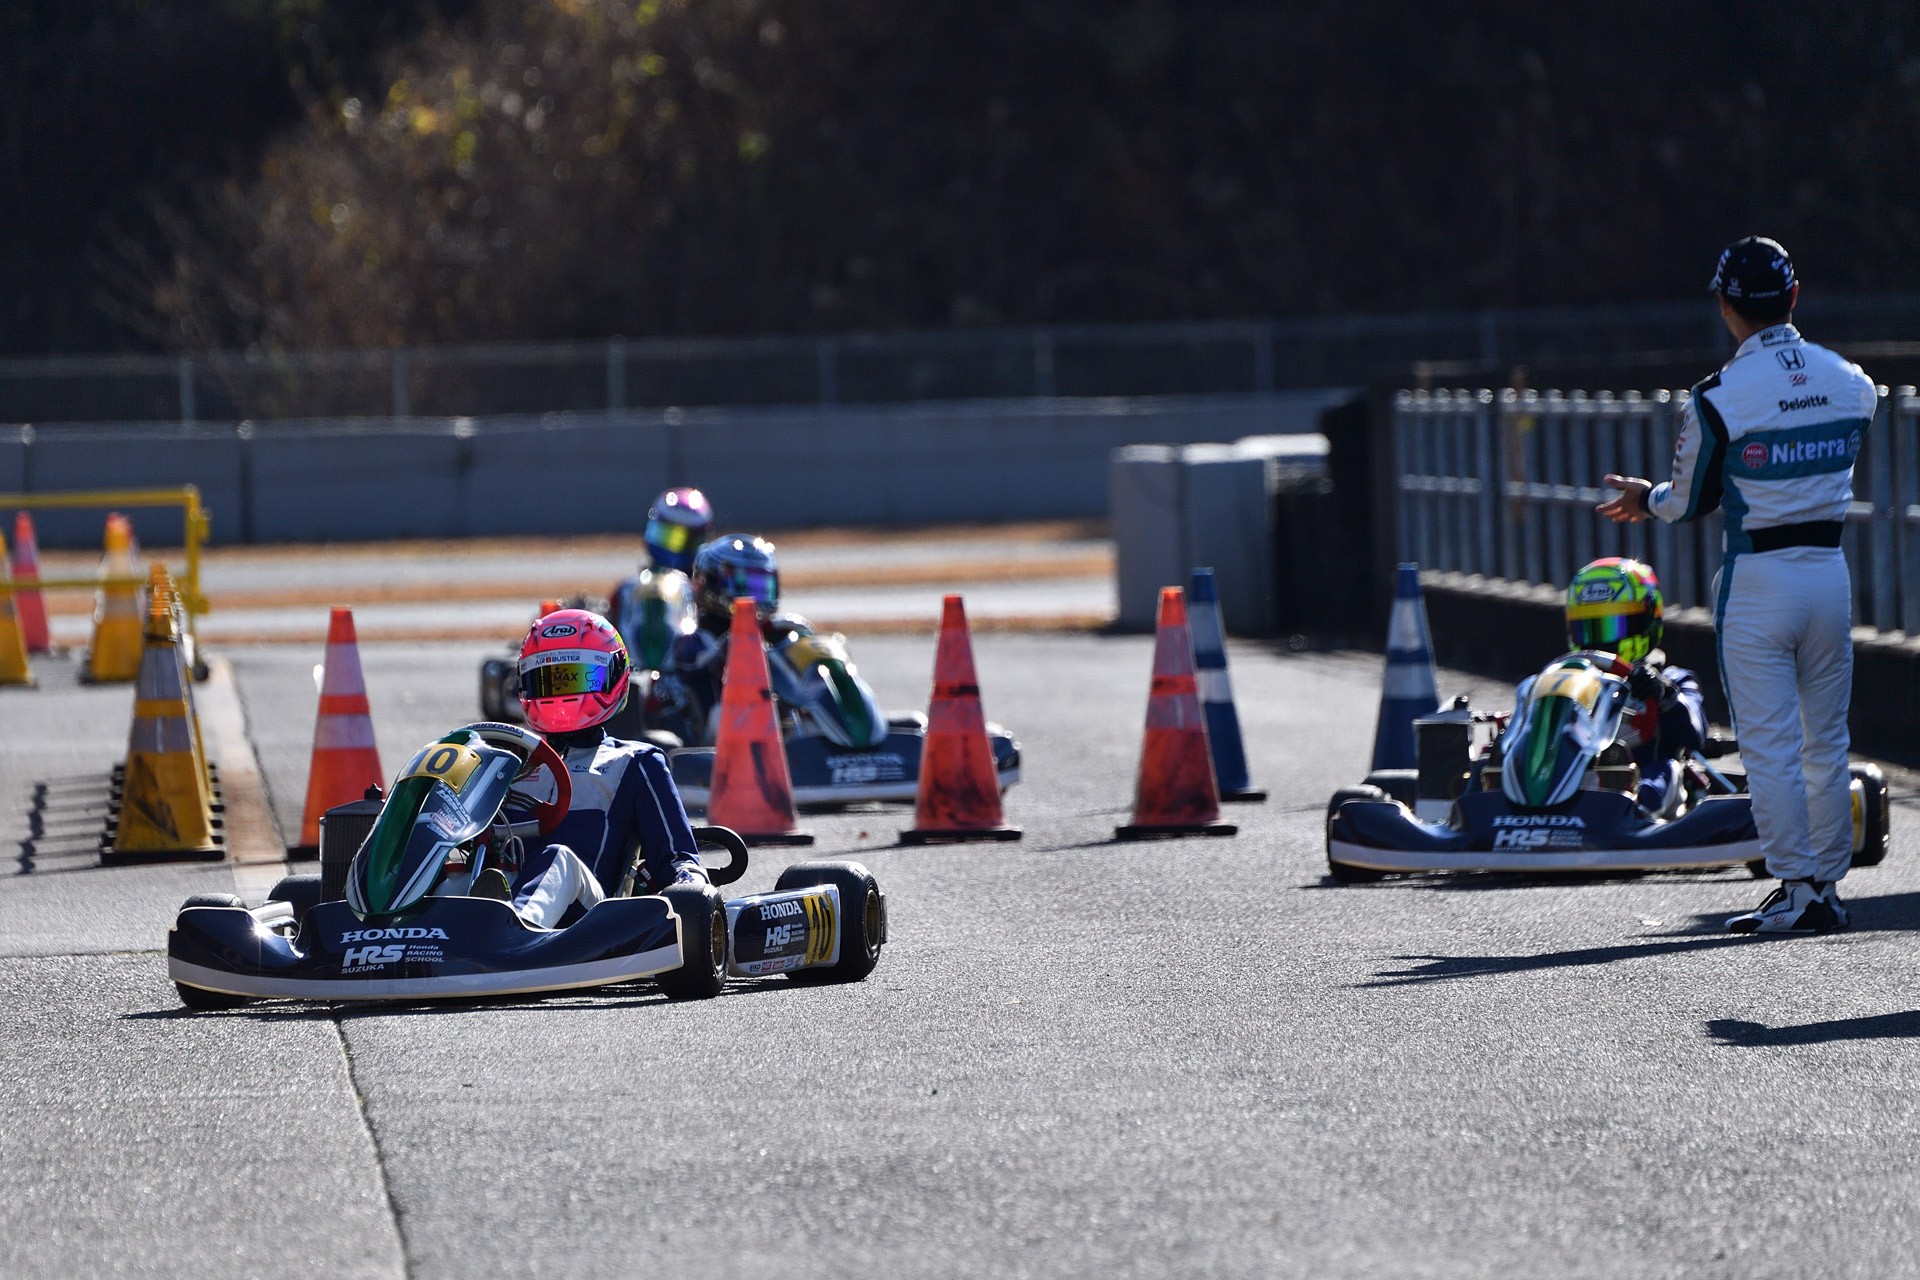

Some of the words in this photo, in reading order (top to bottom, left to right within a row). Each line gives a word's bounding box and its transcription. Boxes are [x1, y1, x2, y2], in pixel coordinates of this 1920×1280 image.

[1771, 438, 1846, 465] Niterra
[551, 655, 581, 663] BUSTER
[1551, 673, 1574, 692] 7
[406, 748, 458, 776] 10
[1491, 815, 1587, 828] HONDA
[1494, 829, 1551, 847] HRS
[760, 900, 803, 921] HONDA
[340, 928, 449, 943] HONDA
[765, 923, 791, 948] HRS
[811, 895, 832, 961] 10
[343, 945, 406, 967] HRS
[341, 964, 384, 974] SUZUKA
